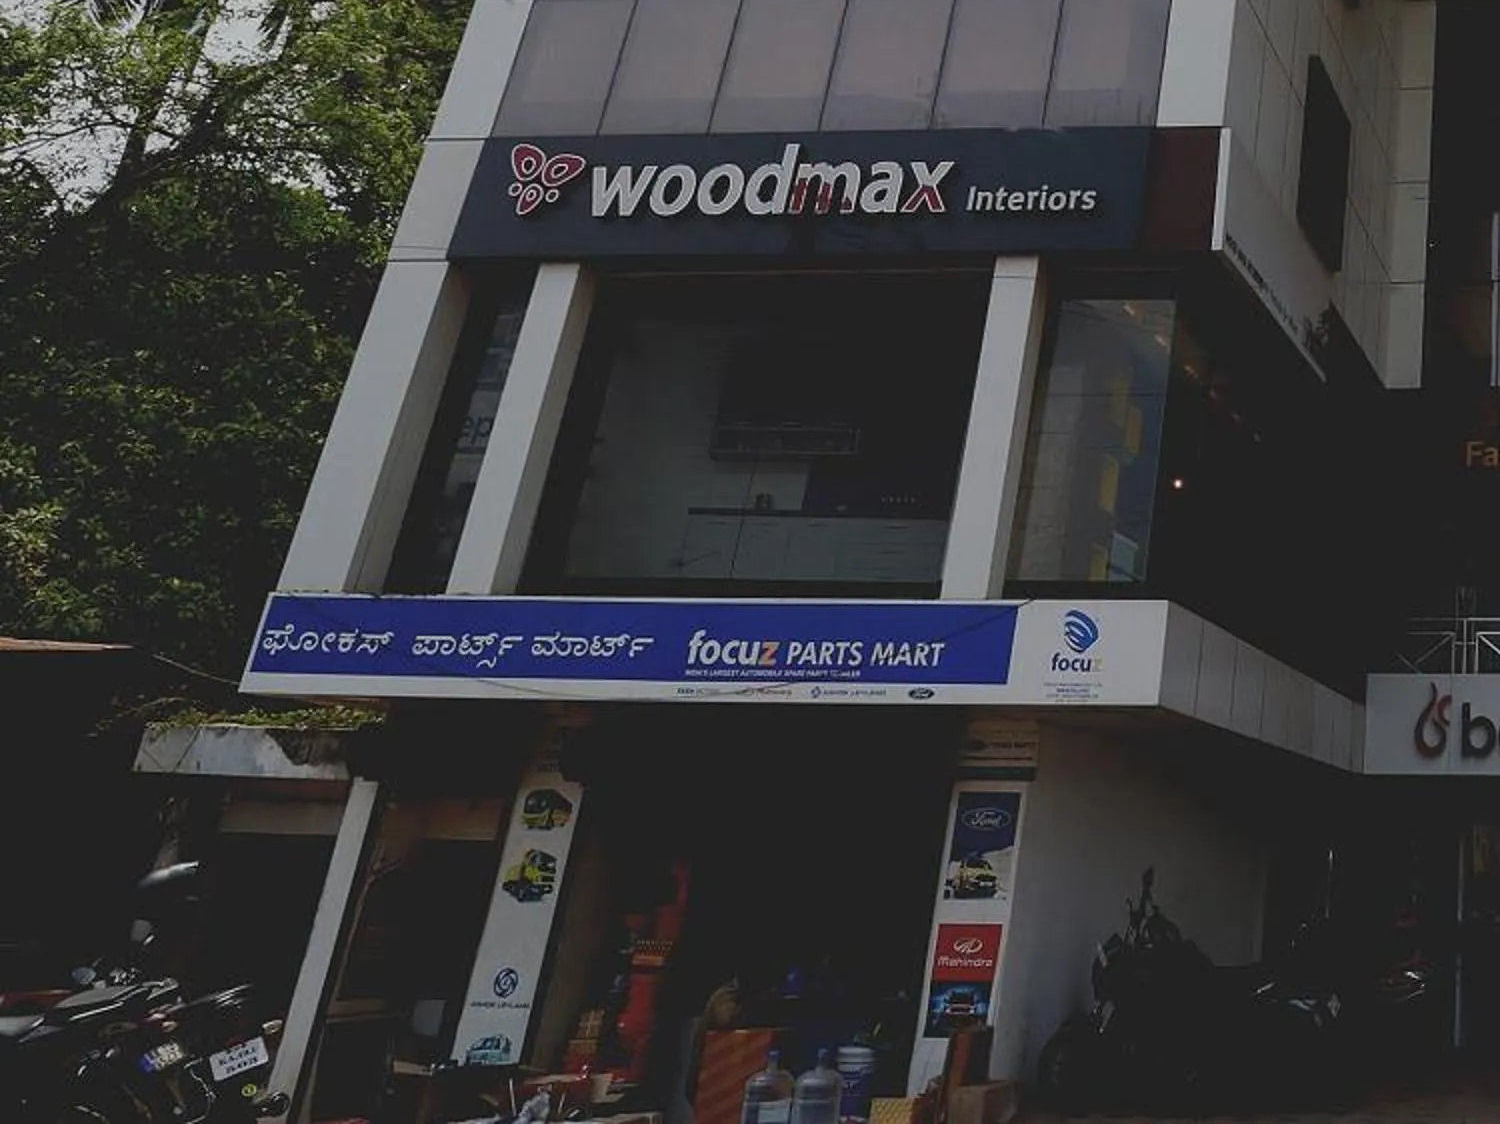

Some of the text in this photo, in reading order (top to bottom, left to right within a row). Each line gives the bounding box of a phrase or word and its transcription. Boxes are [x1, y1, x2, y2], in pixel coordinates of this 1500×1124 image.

[590, 143, 1097, 217] woodmax Interiors
[686, 629, 945, 667] focuz PARTS MART
